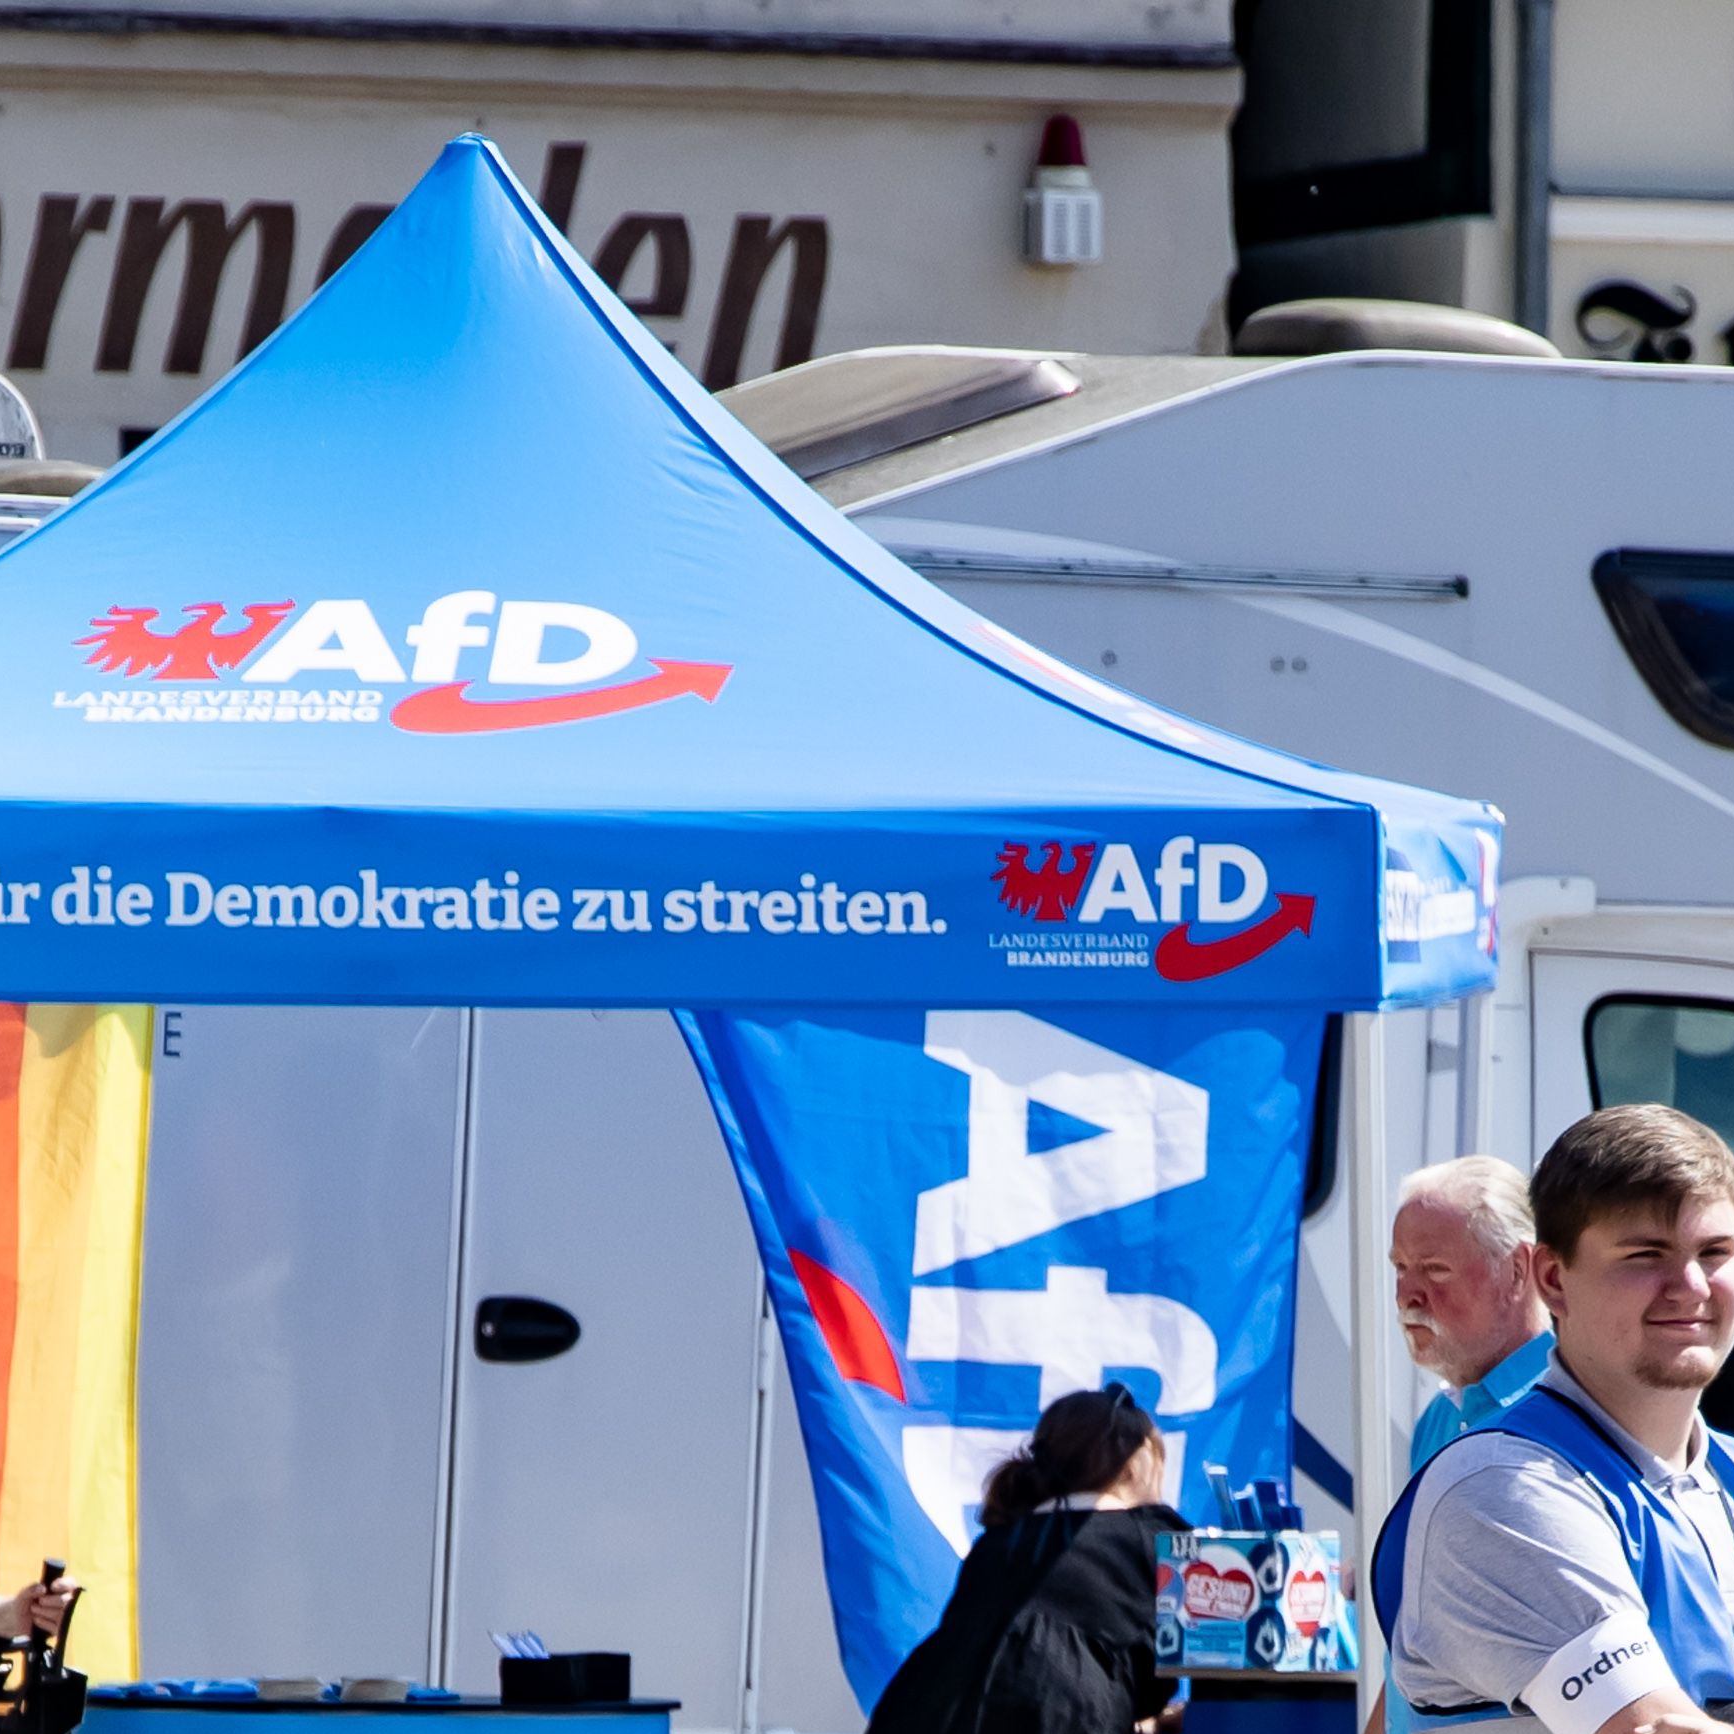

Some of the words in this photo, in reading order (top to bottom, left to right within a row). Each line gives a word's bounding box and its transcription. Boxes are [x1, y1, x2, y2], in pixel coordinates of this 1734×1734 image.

[240, 589, 639, 686] AfD
[52, 690, 384, 708] LANDESVERBAND
[83, 706, 380, 722] BRANDENBURG
[1078, 836, 1268, 924] AfD
[51, 865, 154, 926] die
[165, 870, 559, 931] Demokratie
[572, 889, 653, 933] zu
[663, 873, 948, 935] streiten.
[988, 933, 1150, 949] LANDESVERBAND
[1007, 951, 1150, 967] BRANDENBURG
